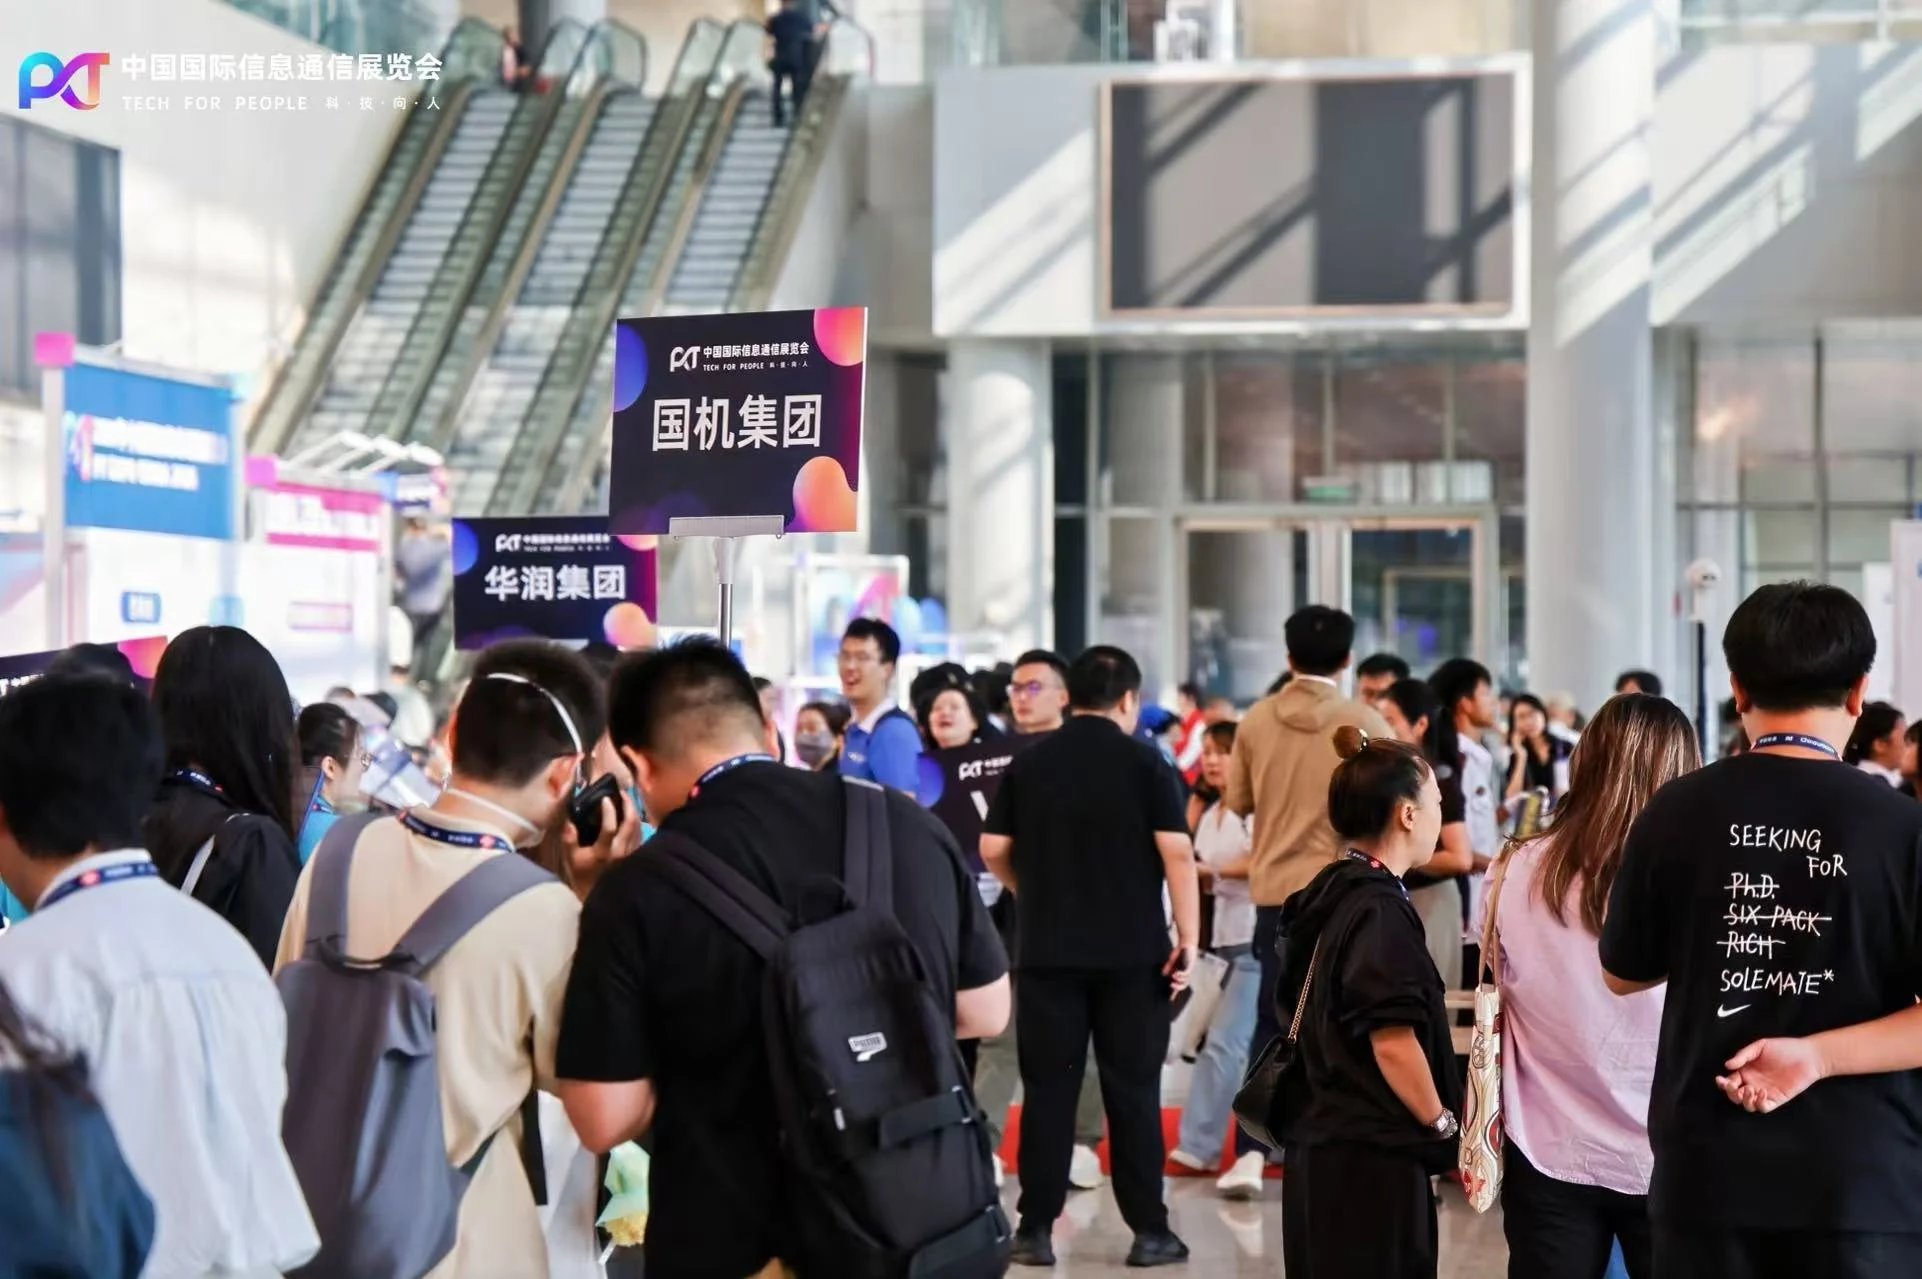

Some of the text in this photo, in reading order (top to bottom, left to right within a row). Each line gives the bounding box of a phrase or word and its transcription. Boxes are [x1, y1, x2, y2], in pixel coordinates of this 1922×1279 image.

[703, 341, 810, 358] 中国国际信息通信展览会
[703, 363, 720, 372] TECH
[723, 363, 736, 371] FOR
[740, 362, 764, 370] PEOPLE
[652, 394, 822, 451] 国机集团
[484, 564, 626, 601] 华润集团
[1729, 824, 1821, 853] SEEKING
[1806, 854, 1848, 878] FOR
[1727, 903, 1822, 936] SIX PACK
[1726, 931, 1774, 959] RICH
